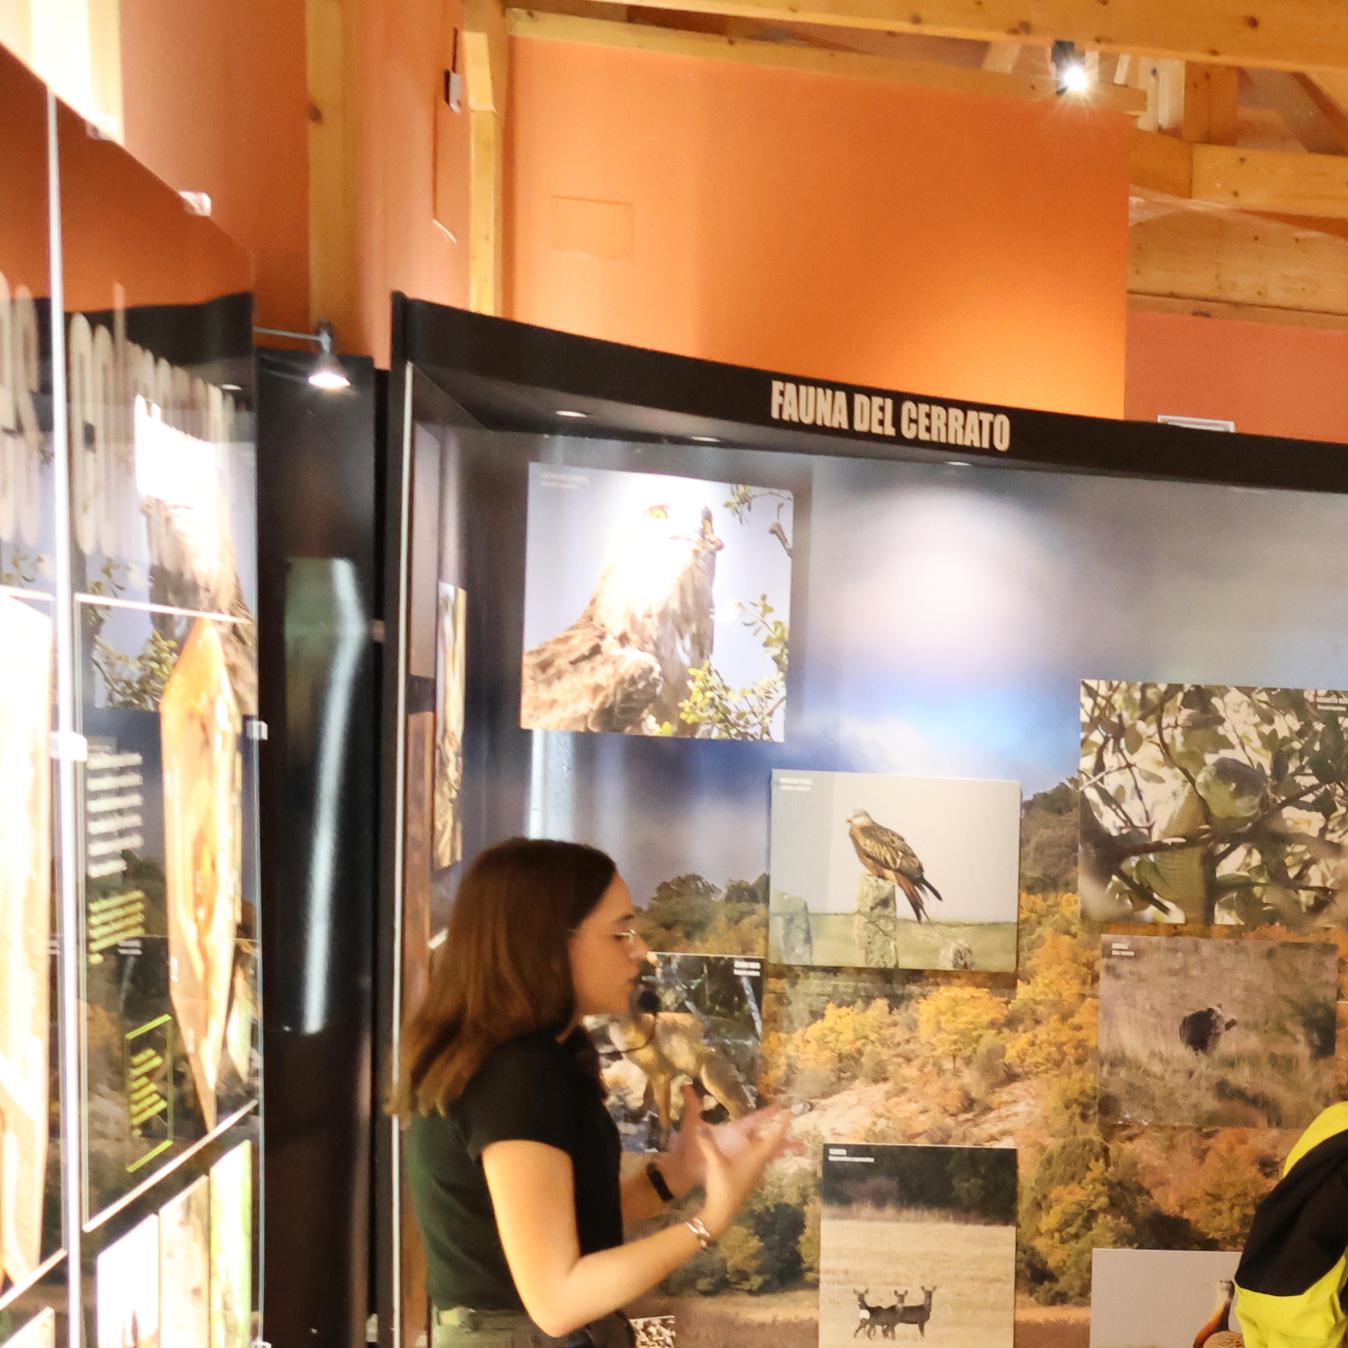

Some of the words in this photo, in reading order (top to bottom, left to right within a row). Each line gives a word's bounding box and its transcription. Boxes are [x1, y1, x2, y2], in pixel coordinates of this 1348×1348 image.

[770, 380, 849, 430] FAUNA
[854, 393, 896, 436] DEL
[901, 400, 1010, 452] CERRATO
